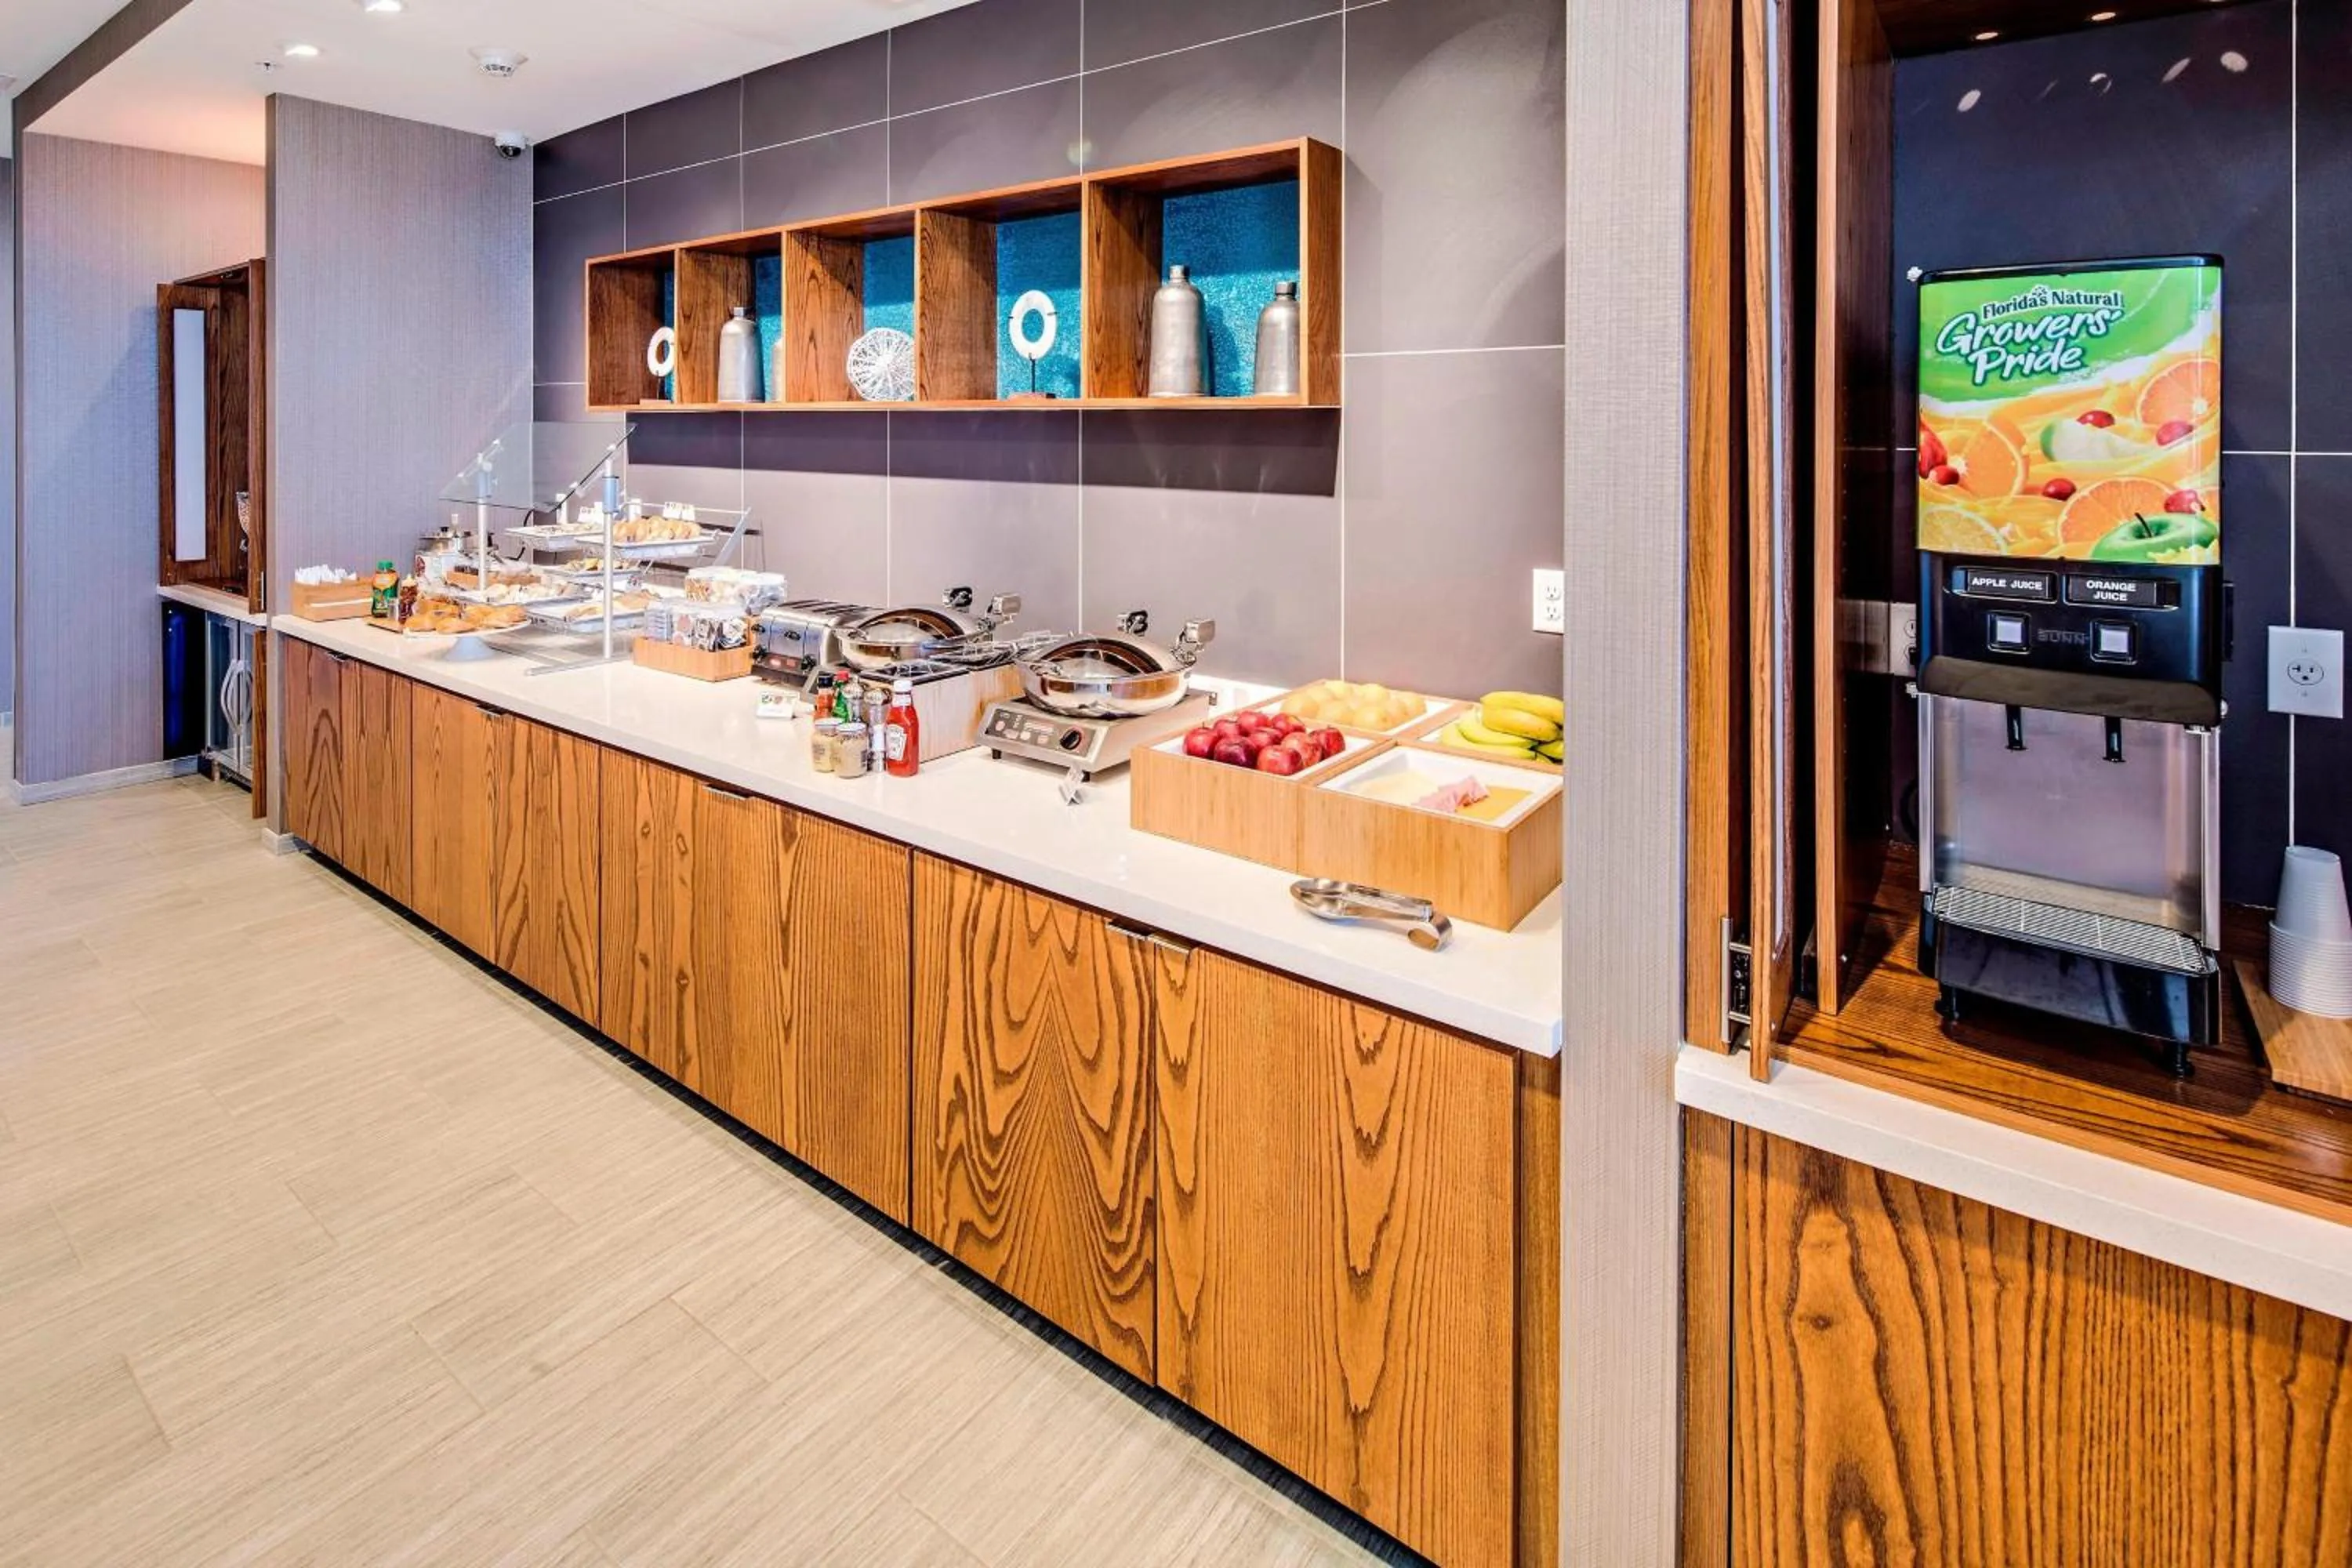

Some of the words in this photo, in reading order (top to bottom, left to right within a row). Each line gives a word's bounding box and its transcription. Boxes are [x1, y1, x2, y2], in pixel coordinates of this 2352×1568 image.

[2052, 291, 2119, 307] Natural
[1967, 336, 2086, 385] Pride
[1972, 577, 2007, 588] APPLE
[2010, 580, 2043, 590] JUICE
[2086, 580, 2136, 592] ORANGE
[2093, 591, 2128, 601] JUICE
